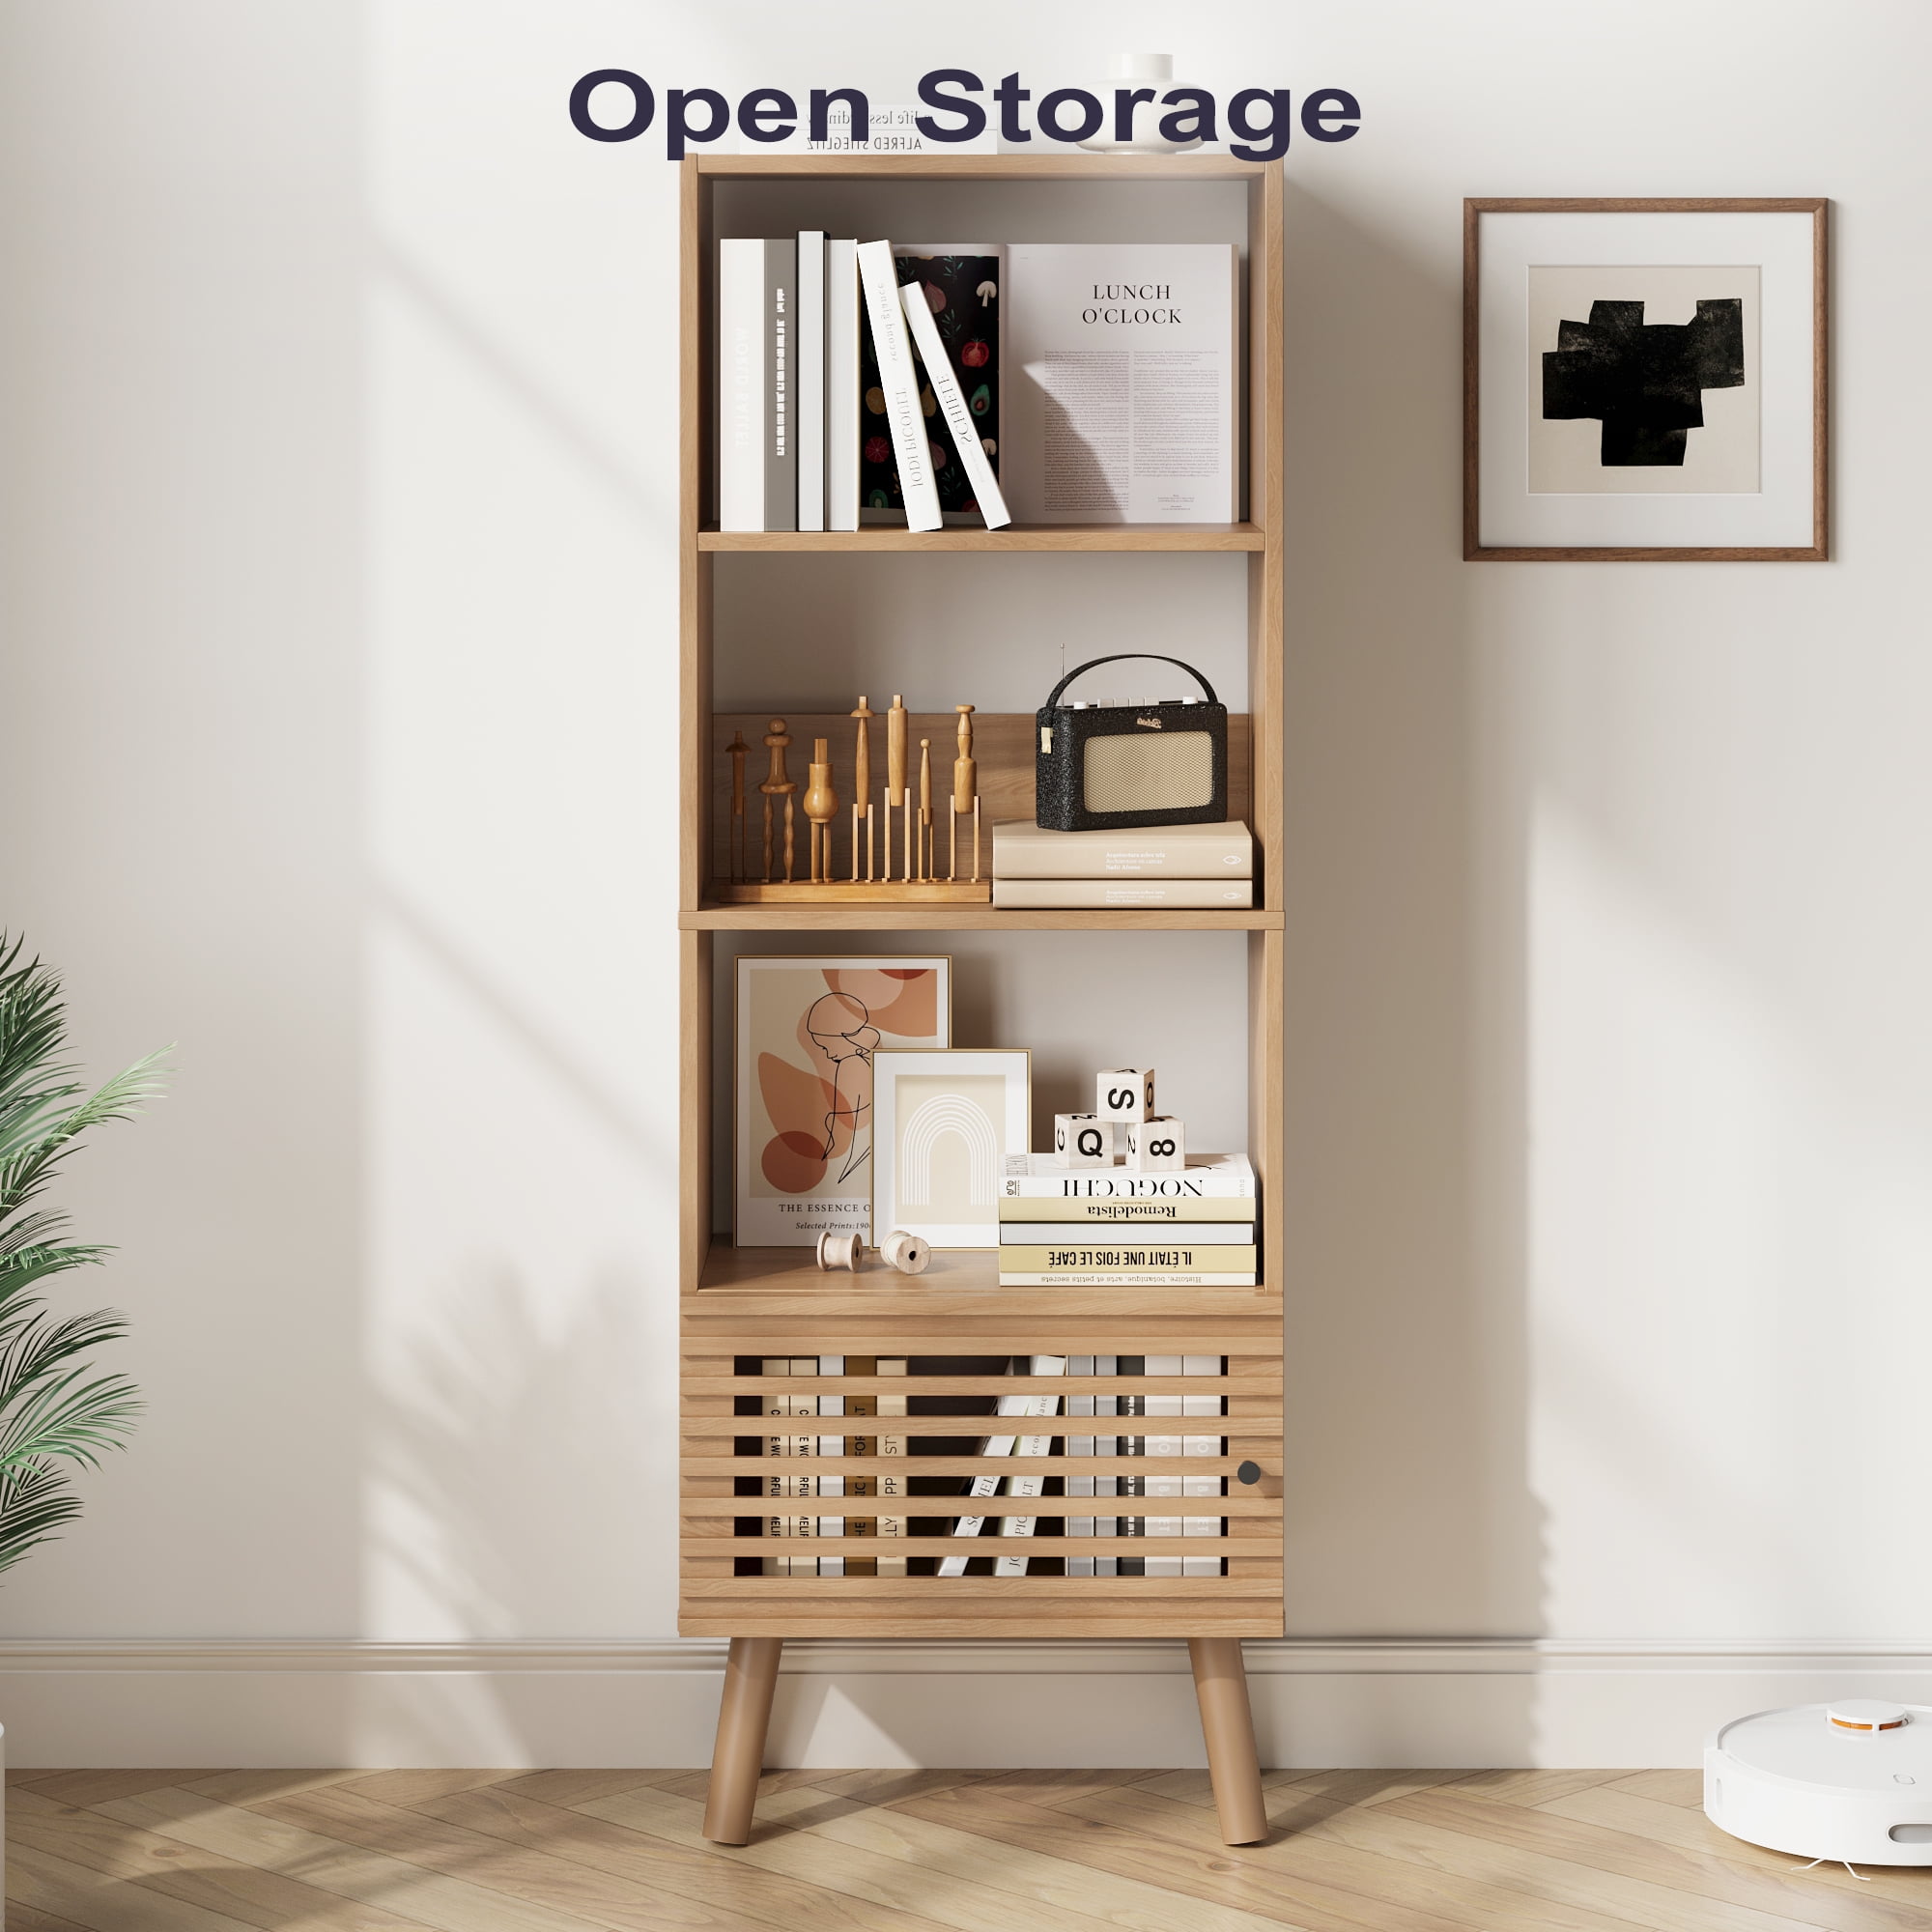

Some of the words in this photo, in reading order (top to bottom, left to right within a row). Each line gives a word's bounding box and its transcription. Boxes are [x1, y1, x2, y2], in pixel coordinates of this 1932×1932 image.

[1093, 284, 1171, 300] LUNCH
[1082, 307, 1182, 325] O'CLOCK
[1108, 1088, 1135, 1110] S
[1077, 1129, 1103, 1157] Q
[1150, 1139, 1176, 1156] 8
[1063, 1179, 1203, 1197] NOGUCHI
[780, 1204, 803, 1212] THE
[807, 1204, 859, 1212] ESSENCE
[864, 1204, 871, 1212] O
[1087, 1206, 1177, 1218] Remodelista
[795, 1221, 827, 1230] Selected
[1048, 1251, 1077, 1267] CAFÉ
[1080, 1251, 1093, 1265] LE
[1095, 1251, 1120, 1265] FOIS
[1123, 1251, 1145, 1265] UNE
[1148, 1251, 1179, 1267] ÉTAIT
[1181, 1251, 1192, 1265] IL
